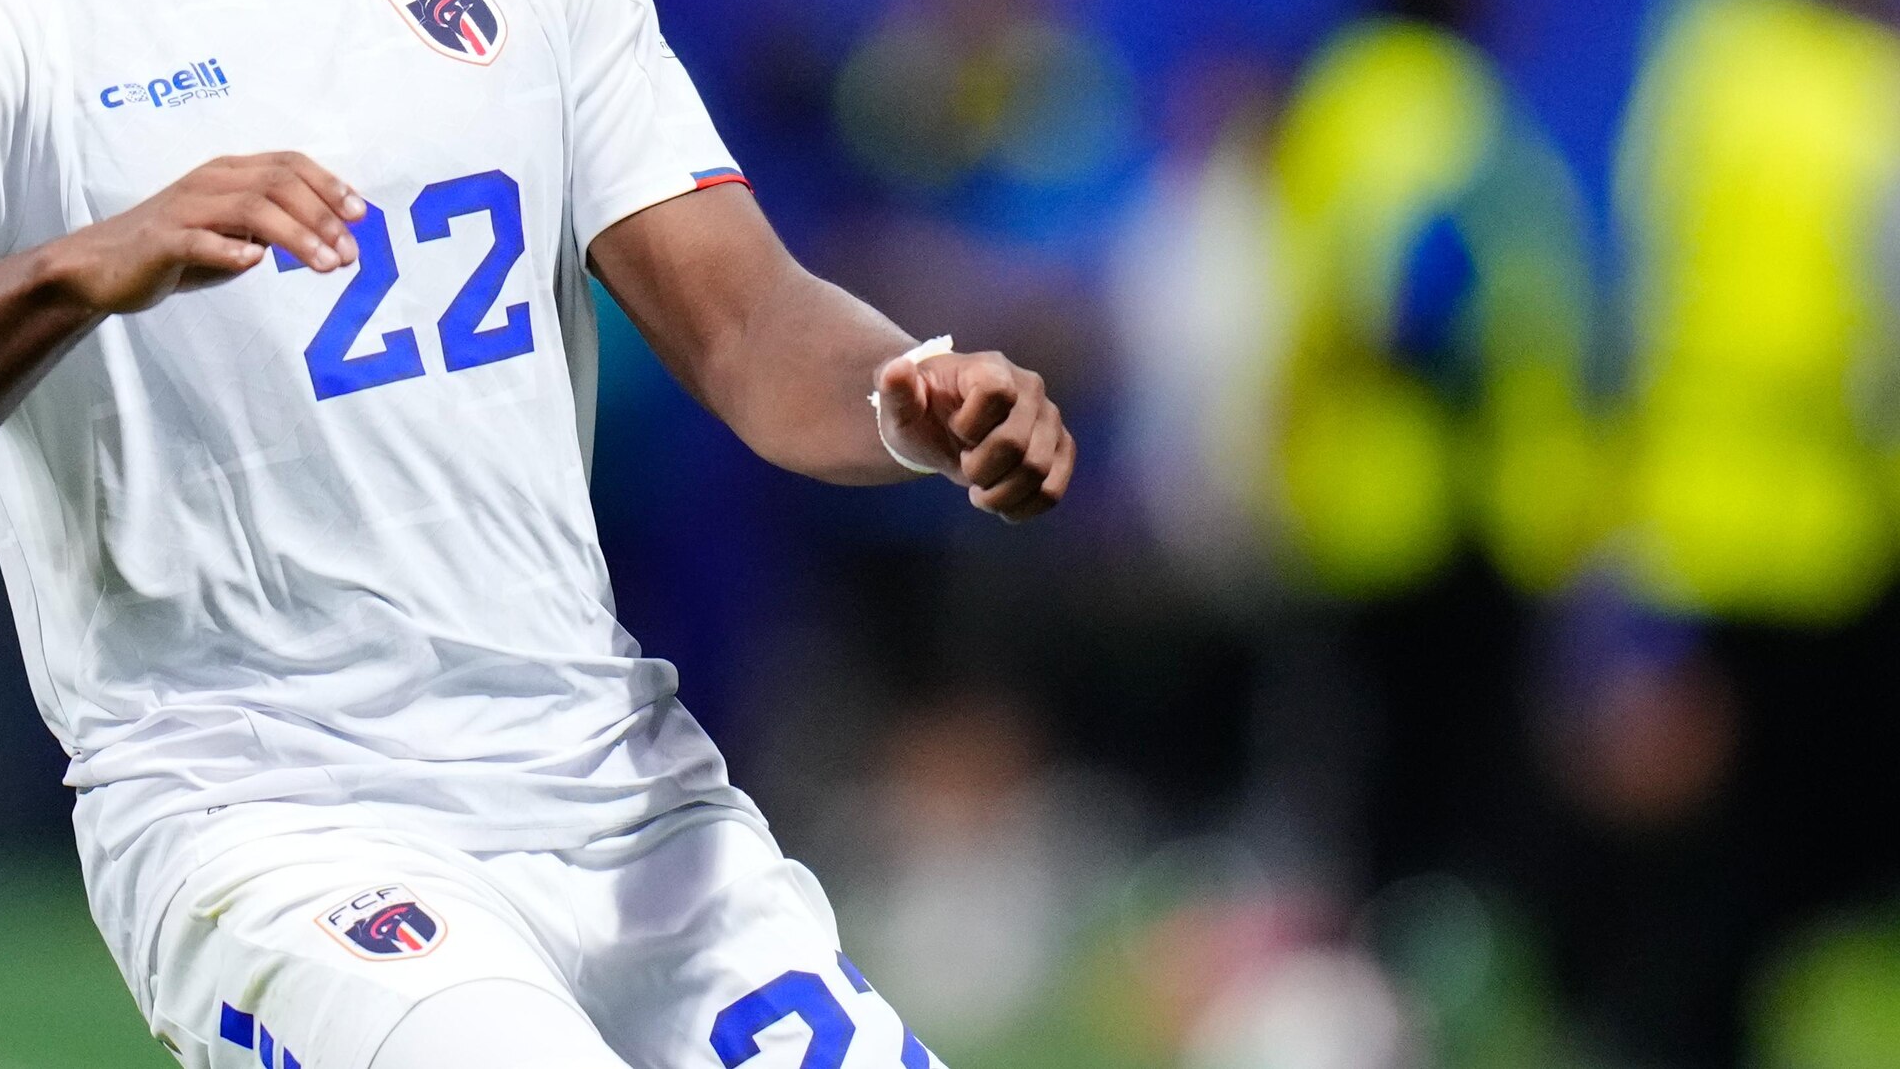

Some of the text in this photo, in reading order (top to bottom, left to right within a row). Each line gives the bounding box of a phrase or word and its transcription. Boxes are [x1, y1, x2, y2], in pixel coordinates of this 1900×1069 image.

[100, 57, 229, 109] capelli
[167, 85, 231, 108] SPORT
[270, 168, 535, 402] 22
[327, 886, 399, 927] FCF
